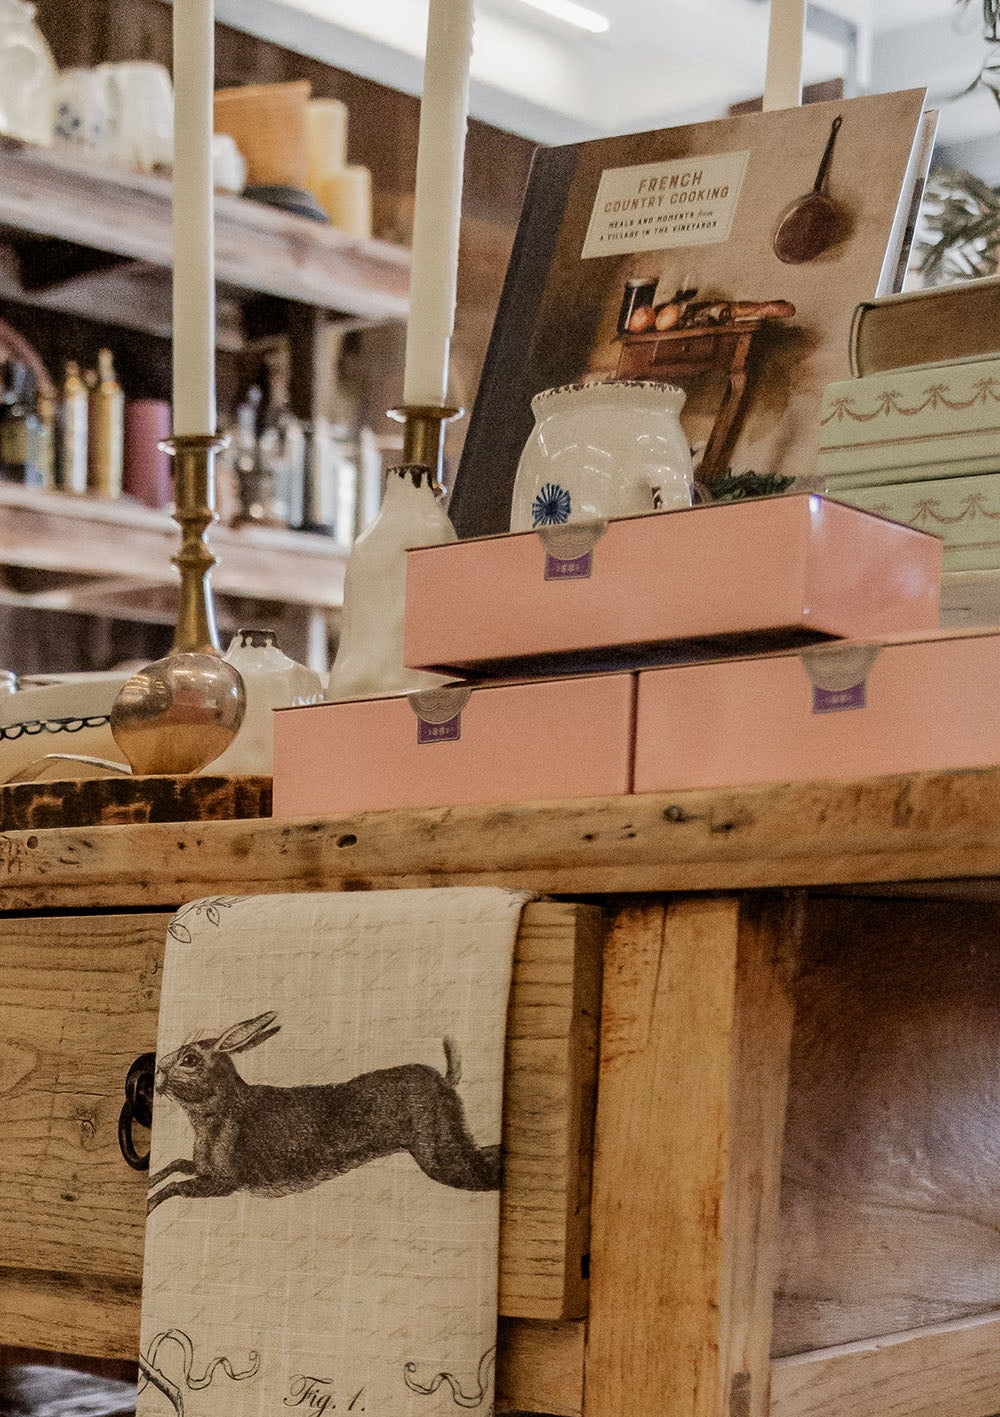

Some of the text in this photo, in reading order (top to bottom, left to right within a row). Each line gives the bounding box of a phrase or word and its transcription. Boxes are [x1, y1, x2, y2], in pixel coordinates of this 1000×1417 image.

[637, 171, 703, 193] FRENCH
[604, 186, 730, 213] COUNTRY COOKING
[607, 230, 640, 241] VILLAGE
[642, 228, 651, 237] IN
[654, 226, 669, 235] THE
[672, 221, 718, 233] VINEYARDS
[608, 219, 634, 230] MEALS
[637, 217, 654, 226] AND
[656, 212, 695, 222] MOMENTS
[347, 1386, 366, 1412] 1.
